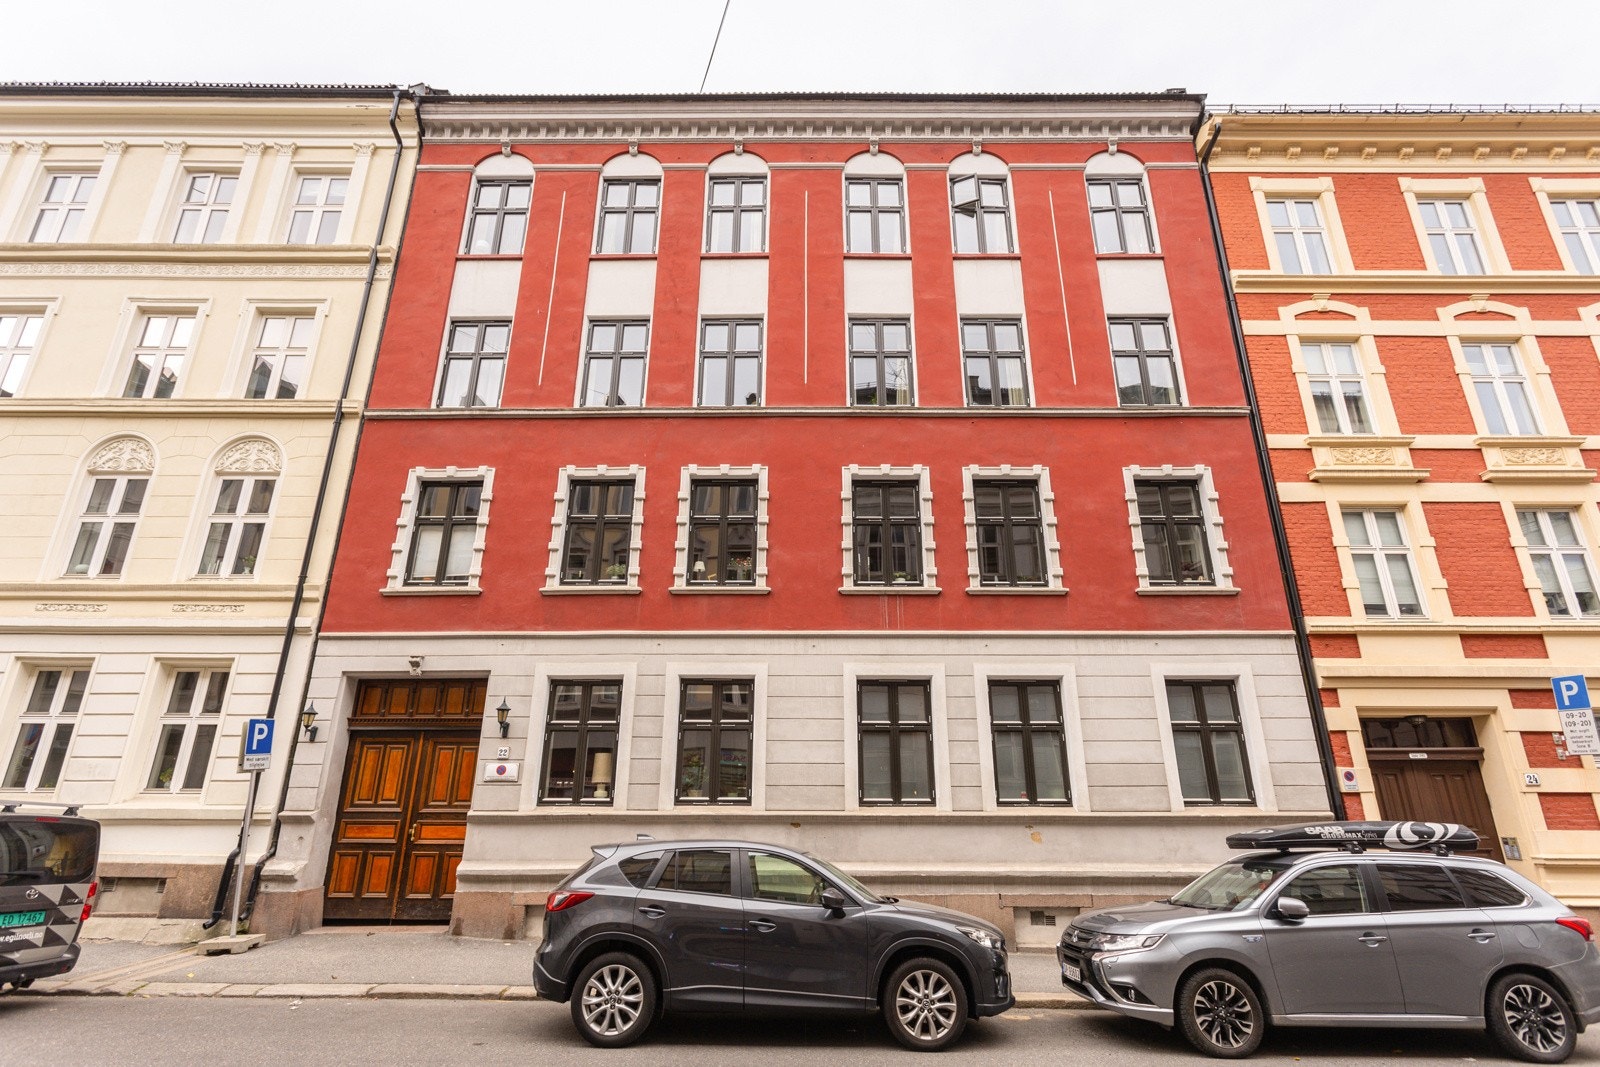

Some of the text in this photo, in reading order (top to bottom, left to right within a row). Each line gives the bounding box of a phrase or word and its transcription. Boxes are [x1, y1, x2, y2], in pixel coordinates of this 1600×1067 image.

[1560, 680, 1578, 705] P
[252, 723, 268, 750] P
[1526, 774, 1539, 784] 24
[1304, 826, 1345, 835] SAAB
[1, 911, 43, 924] ED 17467
